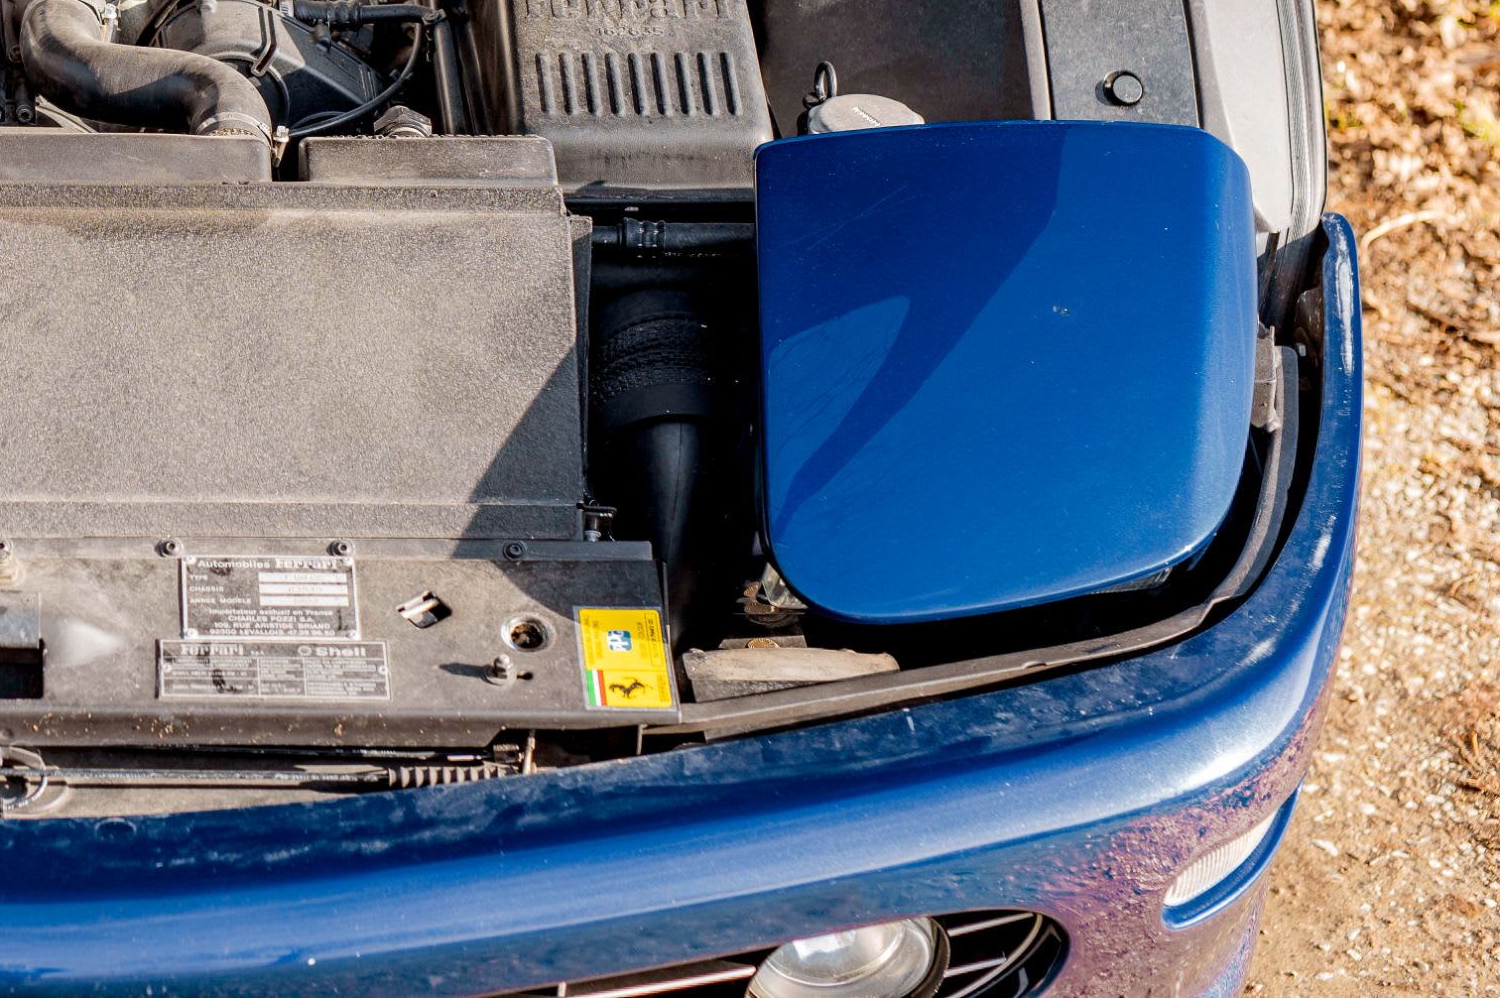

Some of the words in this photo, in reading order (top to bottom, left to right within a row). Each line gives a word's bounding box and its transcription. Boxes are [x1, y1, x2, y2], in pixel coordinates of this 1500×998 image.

[197, 558, 271, 569] Automobiles
[275, 557, 339, 570] Ferrari
[180, 643, 245, 656] Ferrari
[315, 646, 367, 657] Shell
